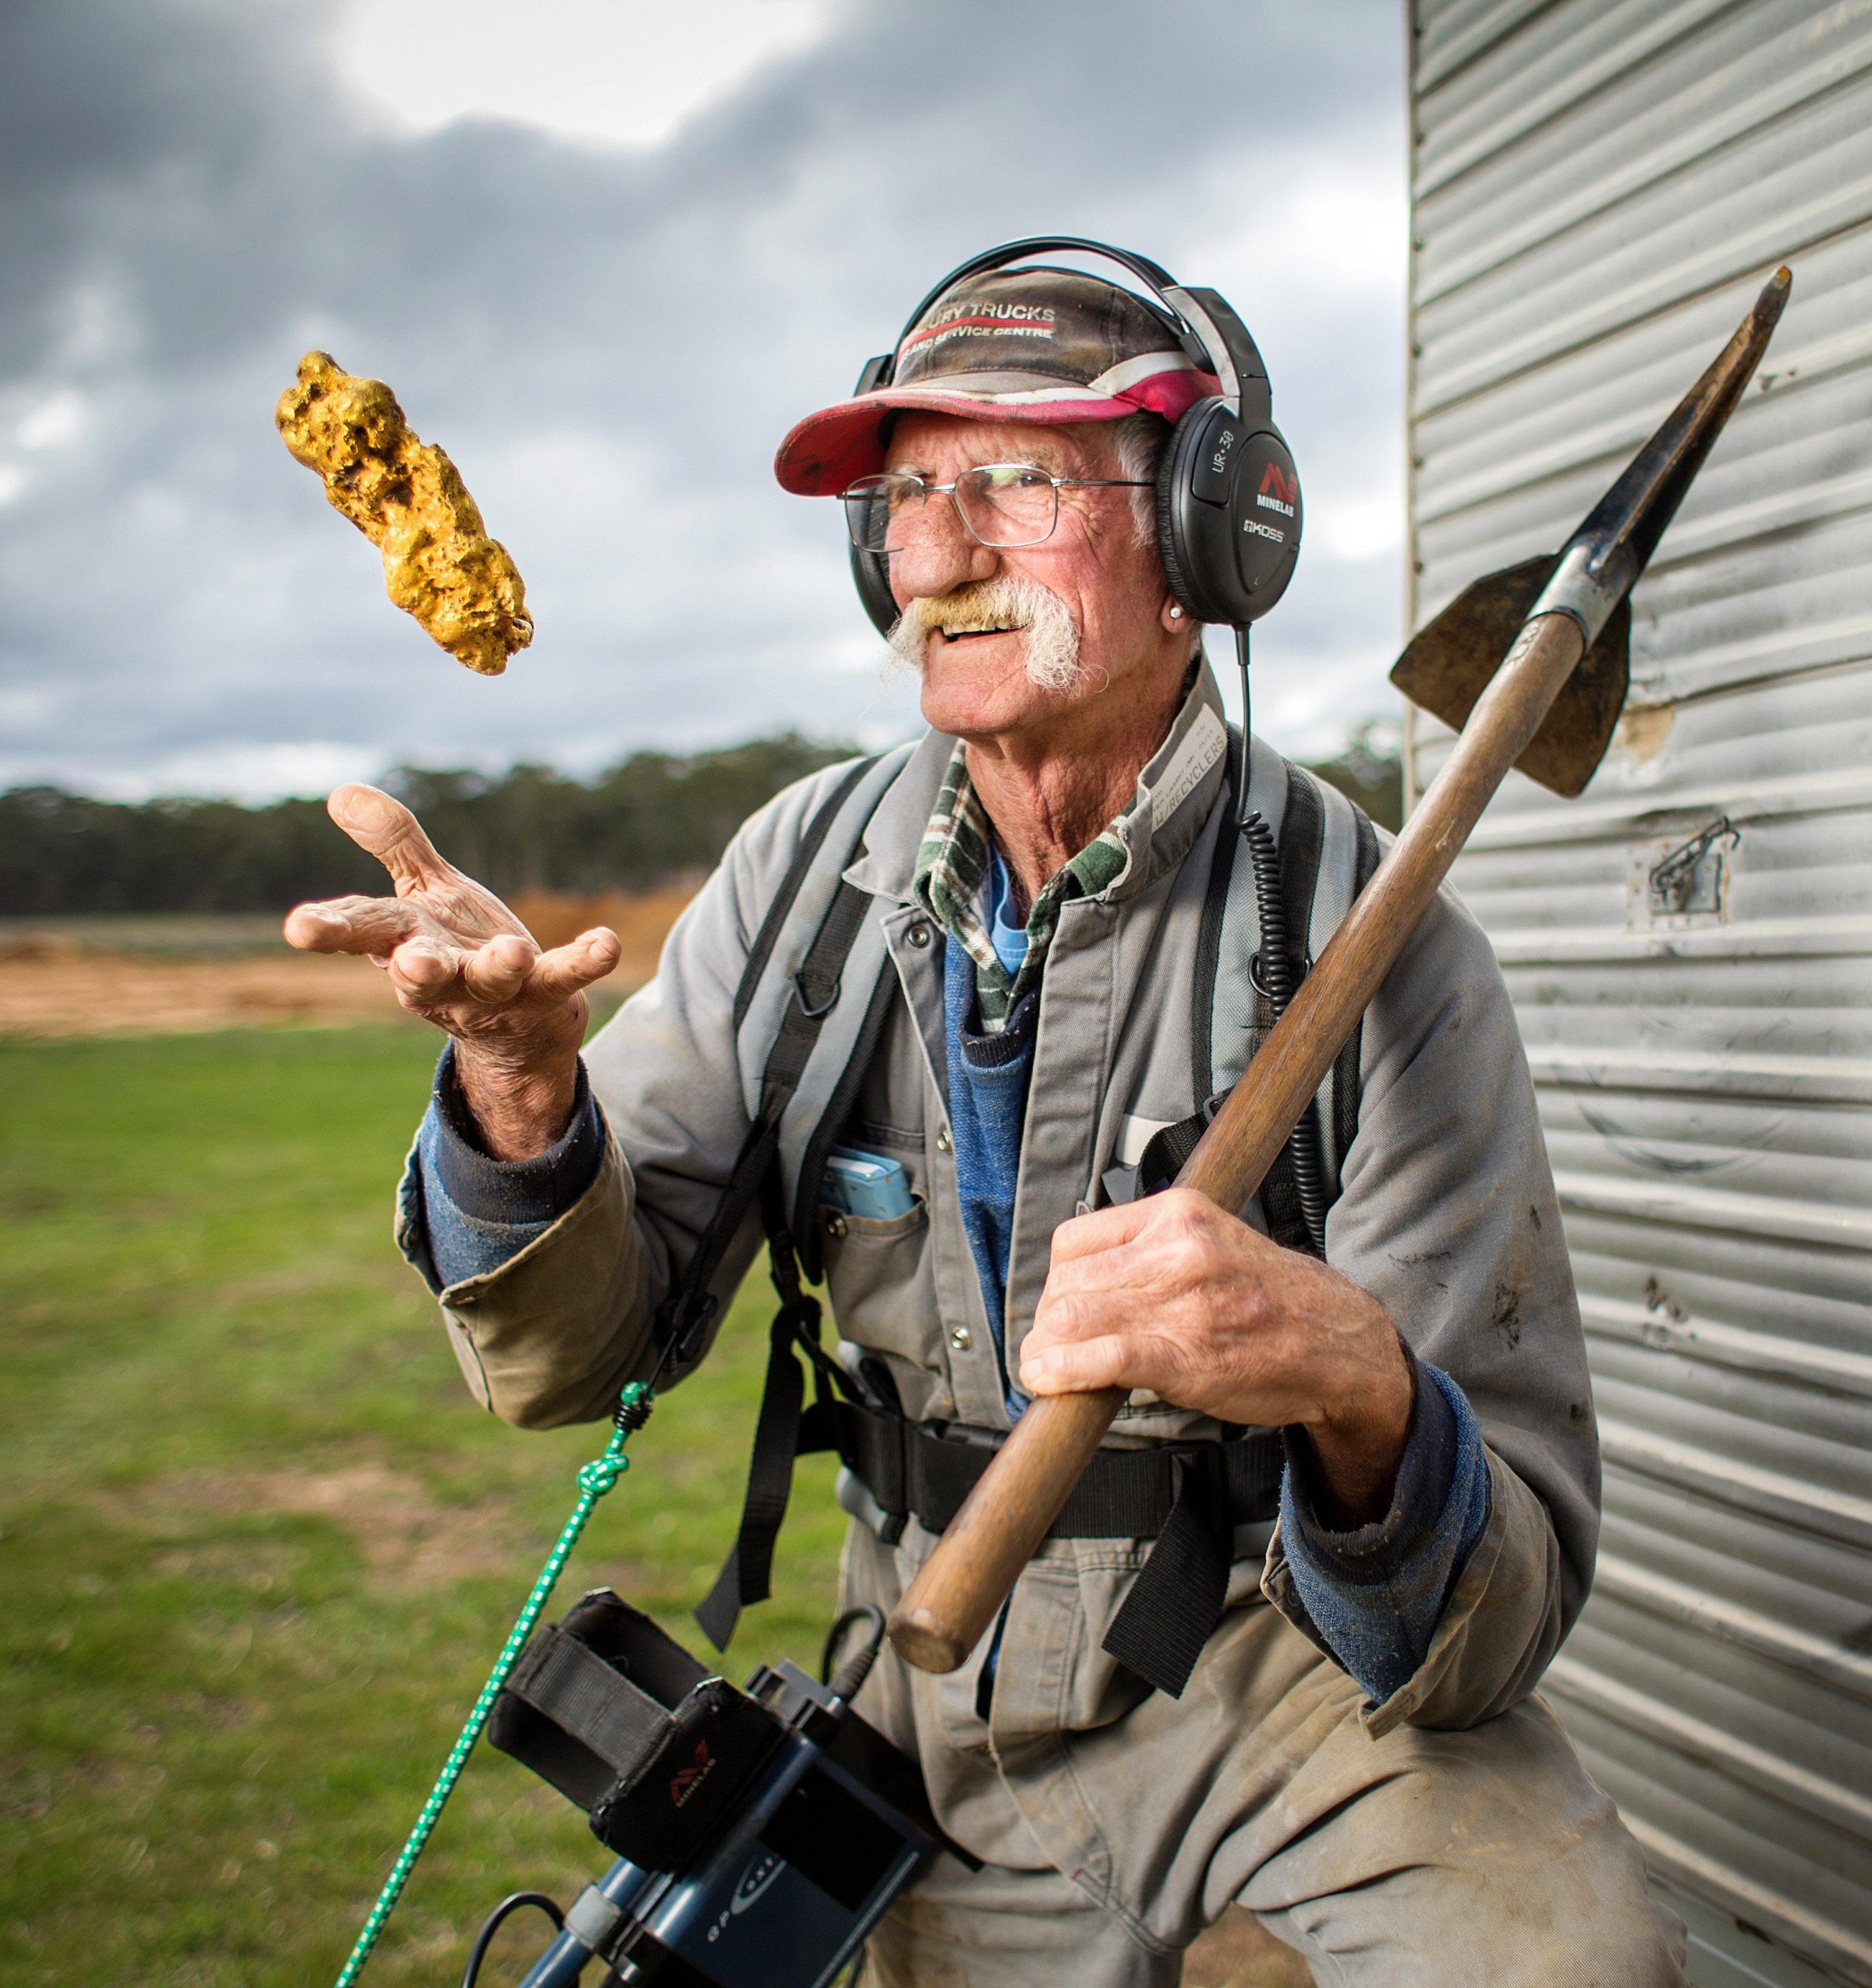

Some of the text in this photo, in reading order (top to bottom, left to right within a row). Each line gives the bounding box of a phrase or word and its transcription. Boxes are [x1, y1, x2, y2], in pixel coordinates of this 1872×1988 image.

[970, 303, 1056, 322] TRUCKS
[934, 325, 993, 346] SERVICE
[993, 327, 1054, 339] CENTRE
[1257, 494, 1294, 518] MINELAB
[1251, 521, 1285, 544] KOSS
